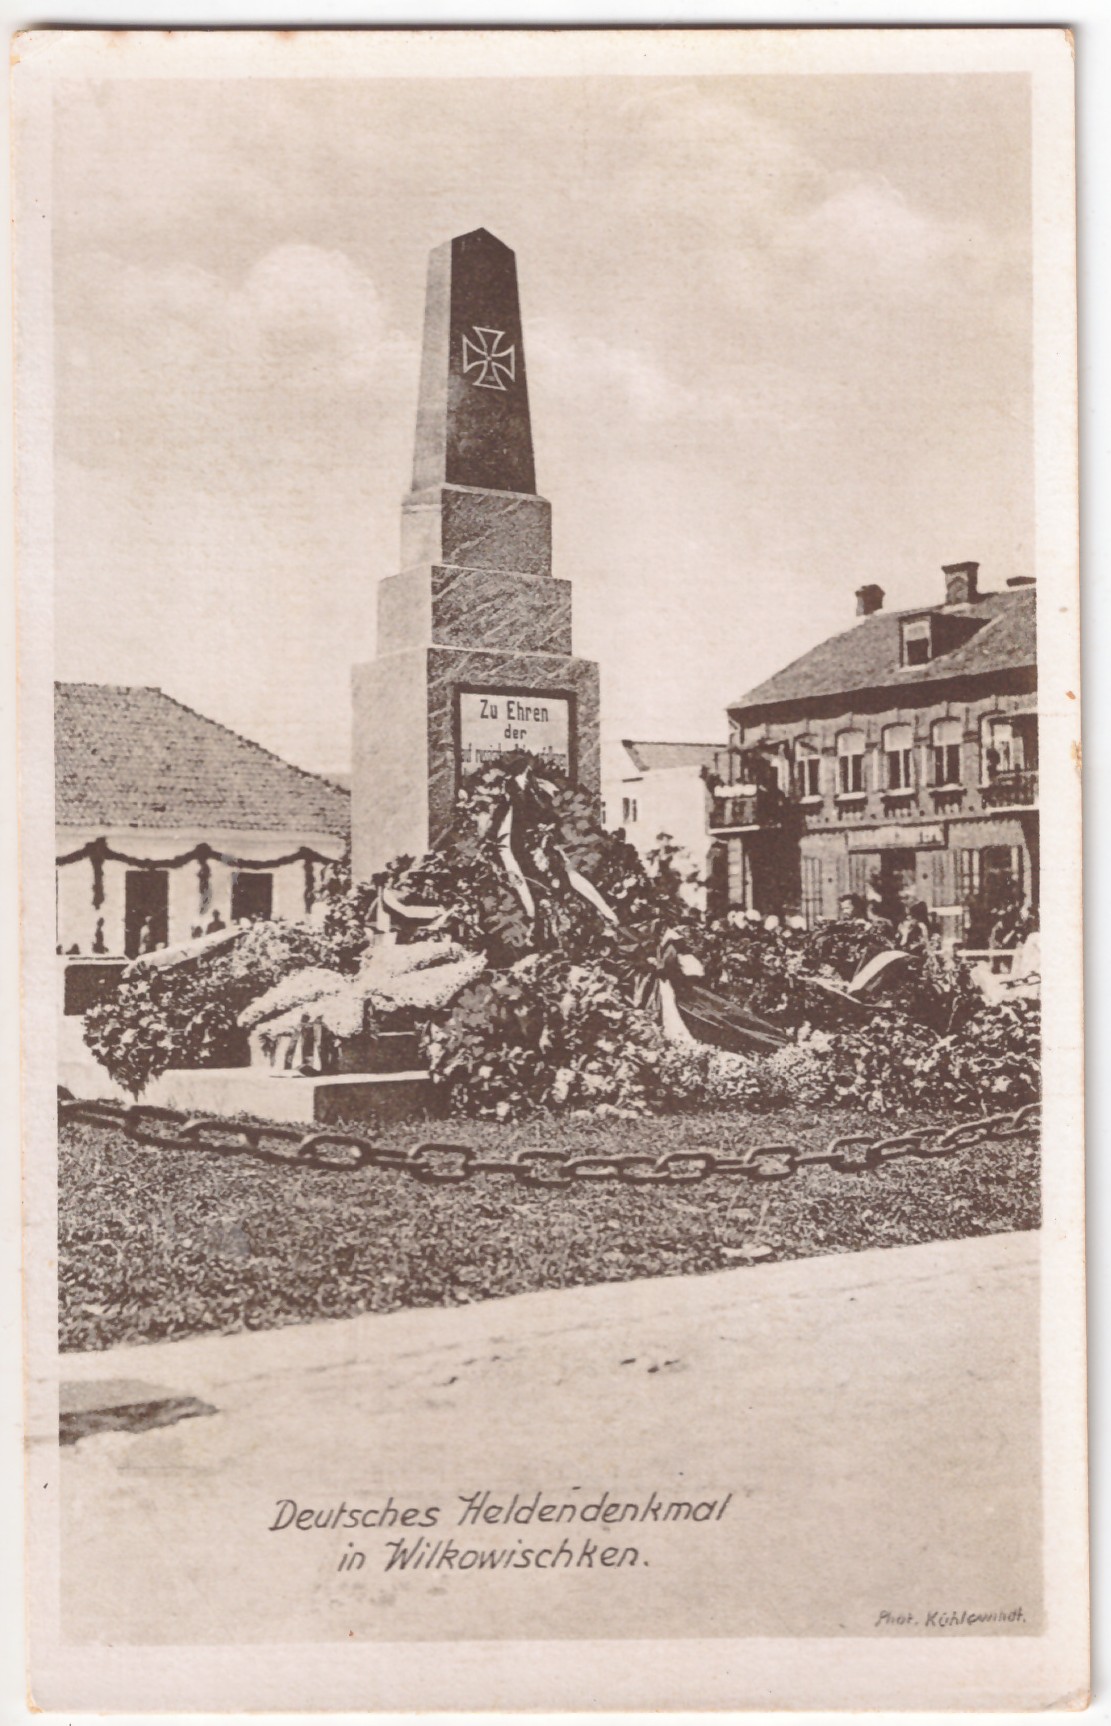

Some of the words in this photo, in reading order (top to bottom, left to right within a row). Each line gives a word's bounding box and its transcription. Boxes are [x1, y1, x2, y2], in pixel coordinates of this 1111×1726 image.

[480, 699, 498, 719] Zu
[506, 700, 549, 723] Ehren
[504, 724, 527, 739] der
